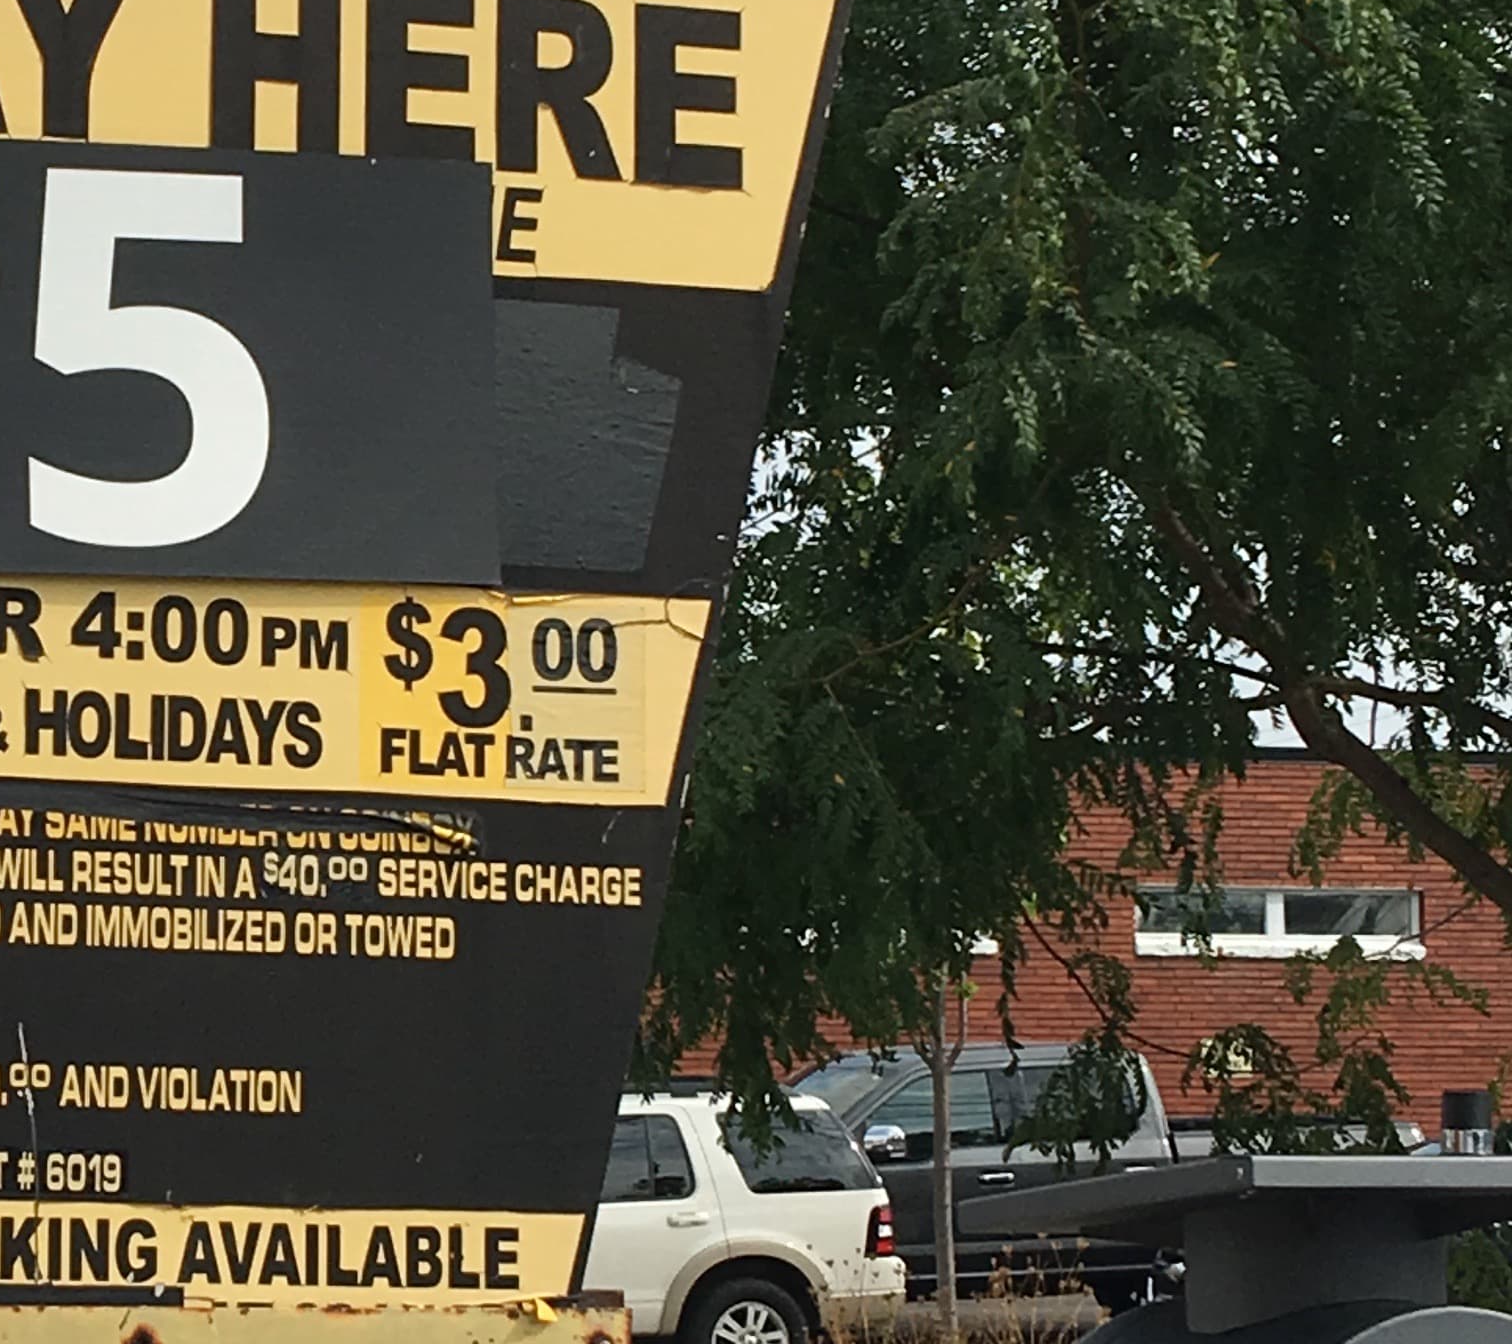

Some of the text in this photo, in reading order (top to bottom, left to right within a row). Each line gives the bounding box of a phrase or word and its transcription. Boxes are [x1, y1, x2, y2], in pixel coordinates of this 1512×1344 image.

[24, 688, 323, 768] HOLIDAYS
[380, 728, 619, 783] FLAT RATE
[72, 851, 188, 896] RESULT
[197, 855, 226, 898] IN
[234, 857, 256, 900] A
[377, 858, 507, 901] SERVICE
[515, 863, 641, 906] CHARGE
[9, 902, 78, 946] AND
[86, 905, 286, 953] IMMOBILIZED
[294, 912, 337, 955] OR
[344, 913, 456, 959] TOWED
[59, 1065, 130, 1109] AND
[137, 1066, 302, 1113] VIOLATION
[46, 1153, 122, 1193] 6019
[178, 1220, 520, 1290] AVAILABLE
